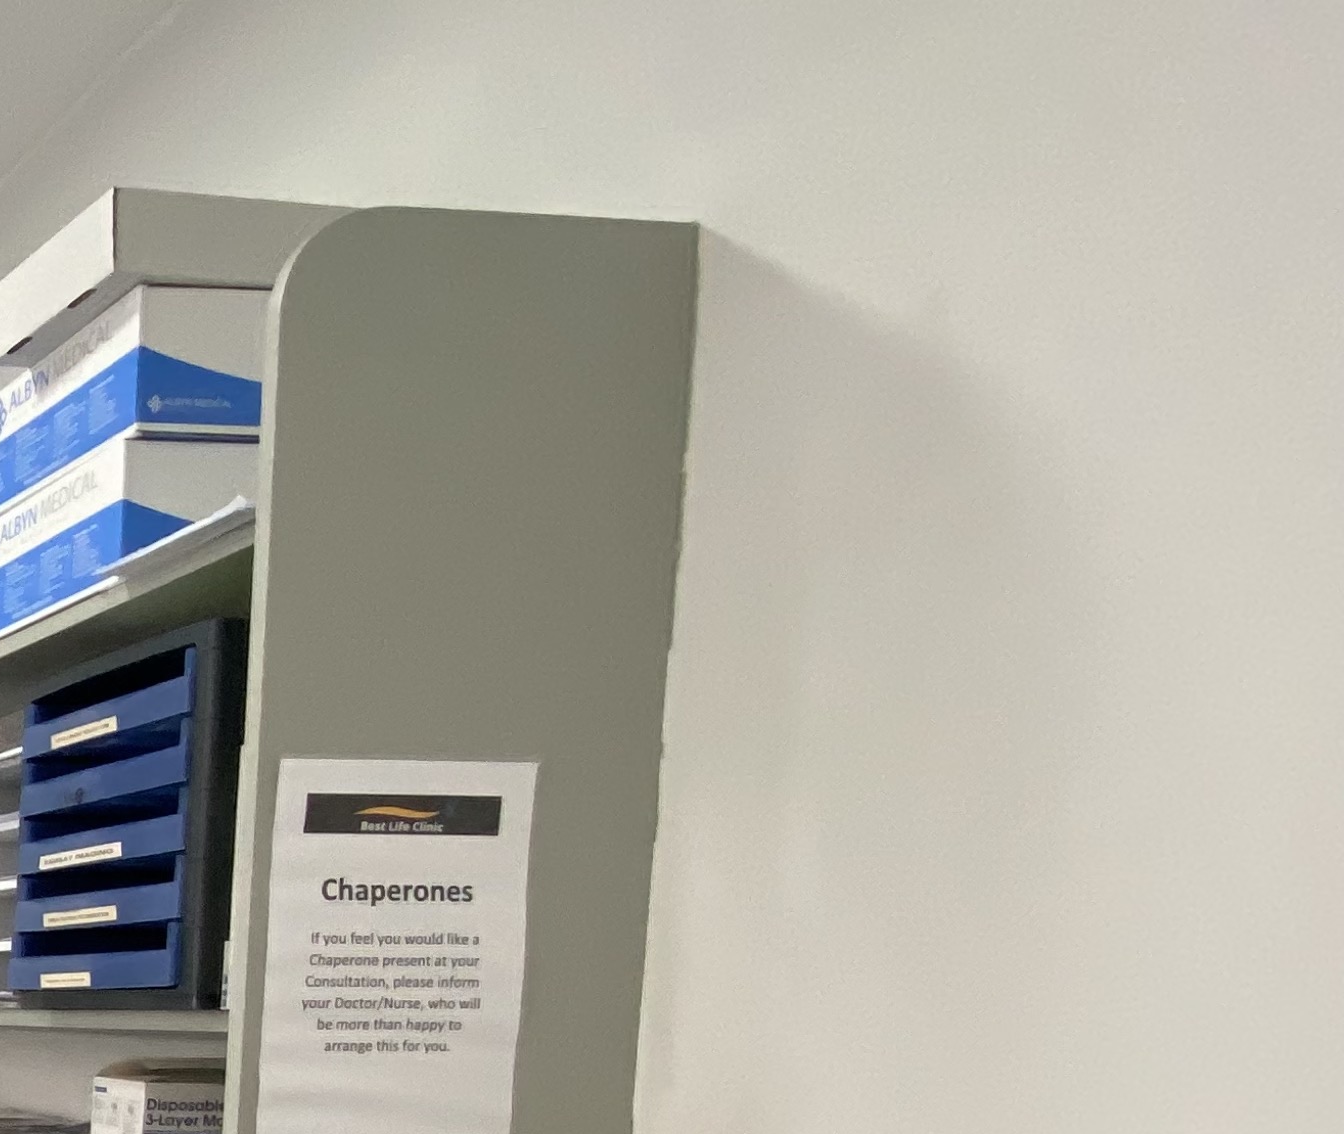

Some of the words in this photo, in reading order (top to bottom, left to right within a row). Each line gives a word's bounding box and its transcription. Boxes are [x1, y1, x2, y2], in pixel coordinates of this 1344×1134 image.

[0, 504, 38, 544] ALBYN
[39, 470, 99, 517] MEDICAL
[360, 820, 386, 832] Best
[389, 821, 410, 832] Life
[413, 821, 444, 833] Clinic
[320, 877, 474, 908] Chaperones
[311, 932, 321, 945] If
[323, 935, 347, 947] you
[350, 932, 374, 945] feel
[377, 935, 401, 947] you
[404, 933, 444, 946] would
[447, 933, 470, 946] like
[309, 954, 379, 969] Chaperone
[382, 956, 431, 968] present
[434, 957, 448, 968] at
[450, 957, 481, 971] your
[305, 976, 390, 990] Consultation,
[392, 976, 434, 990] please
[437, 977, 480, 989] inform
[301, 999, 332, 1012] your
[334, 996, 425, 1011] Doctor/Nurse,
[427, 998, 457, 1010] who
[459, 998, 482, 1010] will
[317, 1018, 334, 1031] be
[335, 1021, 371, 1031] more
[373, 1019, 403, 1031] than
[405, 1018, 446, 1034] happy
[448, 1020, 463, 1031] to
[324, 1043, 374, 1054] arrange
[376, 1040, 400, 1052] this
[402, 1040, 422, 1052] for
[423, 1043, 452, 1055] you.
[145, 1113, 199, 1128] 3-Layer
